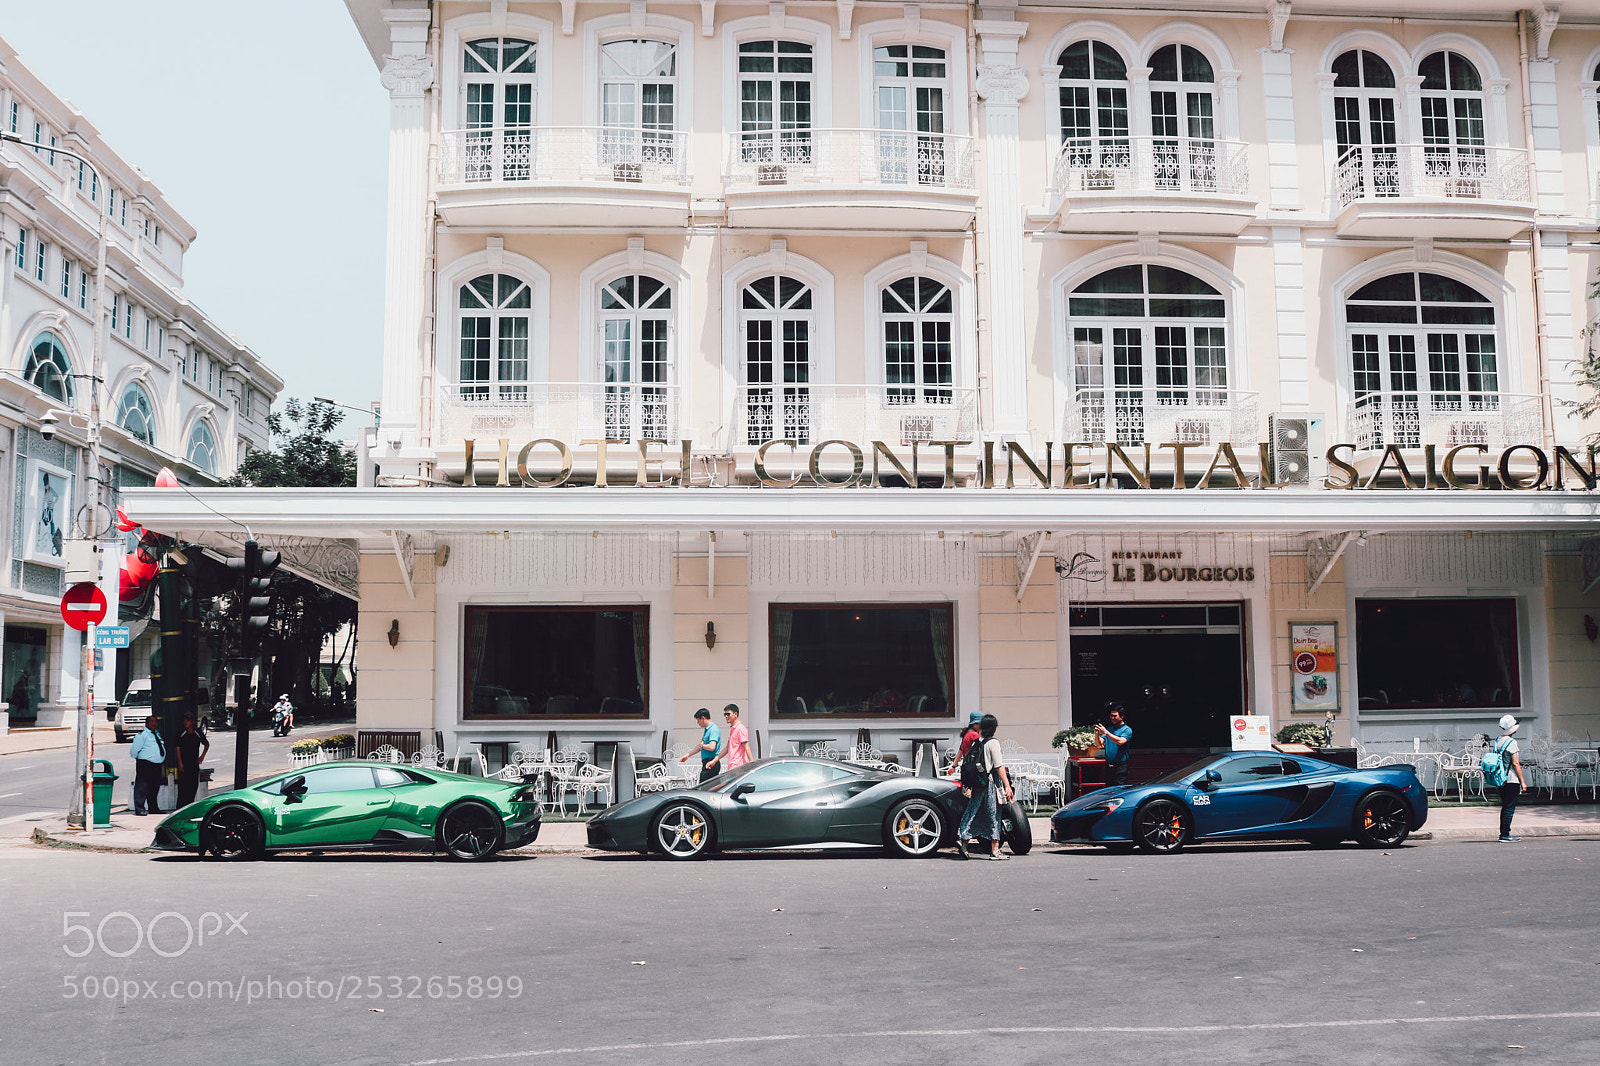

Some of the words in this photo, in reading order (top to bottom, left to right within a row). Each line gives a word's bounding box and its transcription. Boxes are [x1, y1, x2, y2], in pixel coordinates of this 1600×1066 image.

[463, 438, 715, 488] HOTEL
[753, 438, 1290, 489] CONTINENTAL
[1324, 443, 1600, 490] SAIGON
[1112, 551, 1183, 559] RESTAURANT
